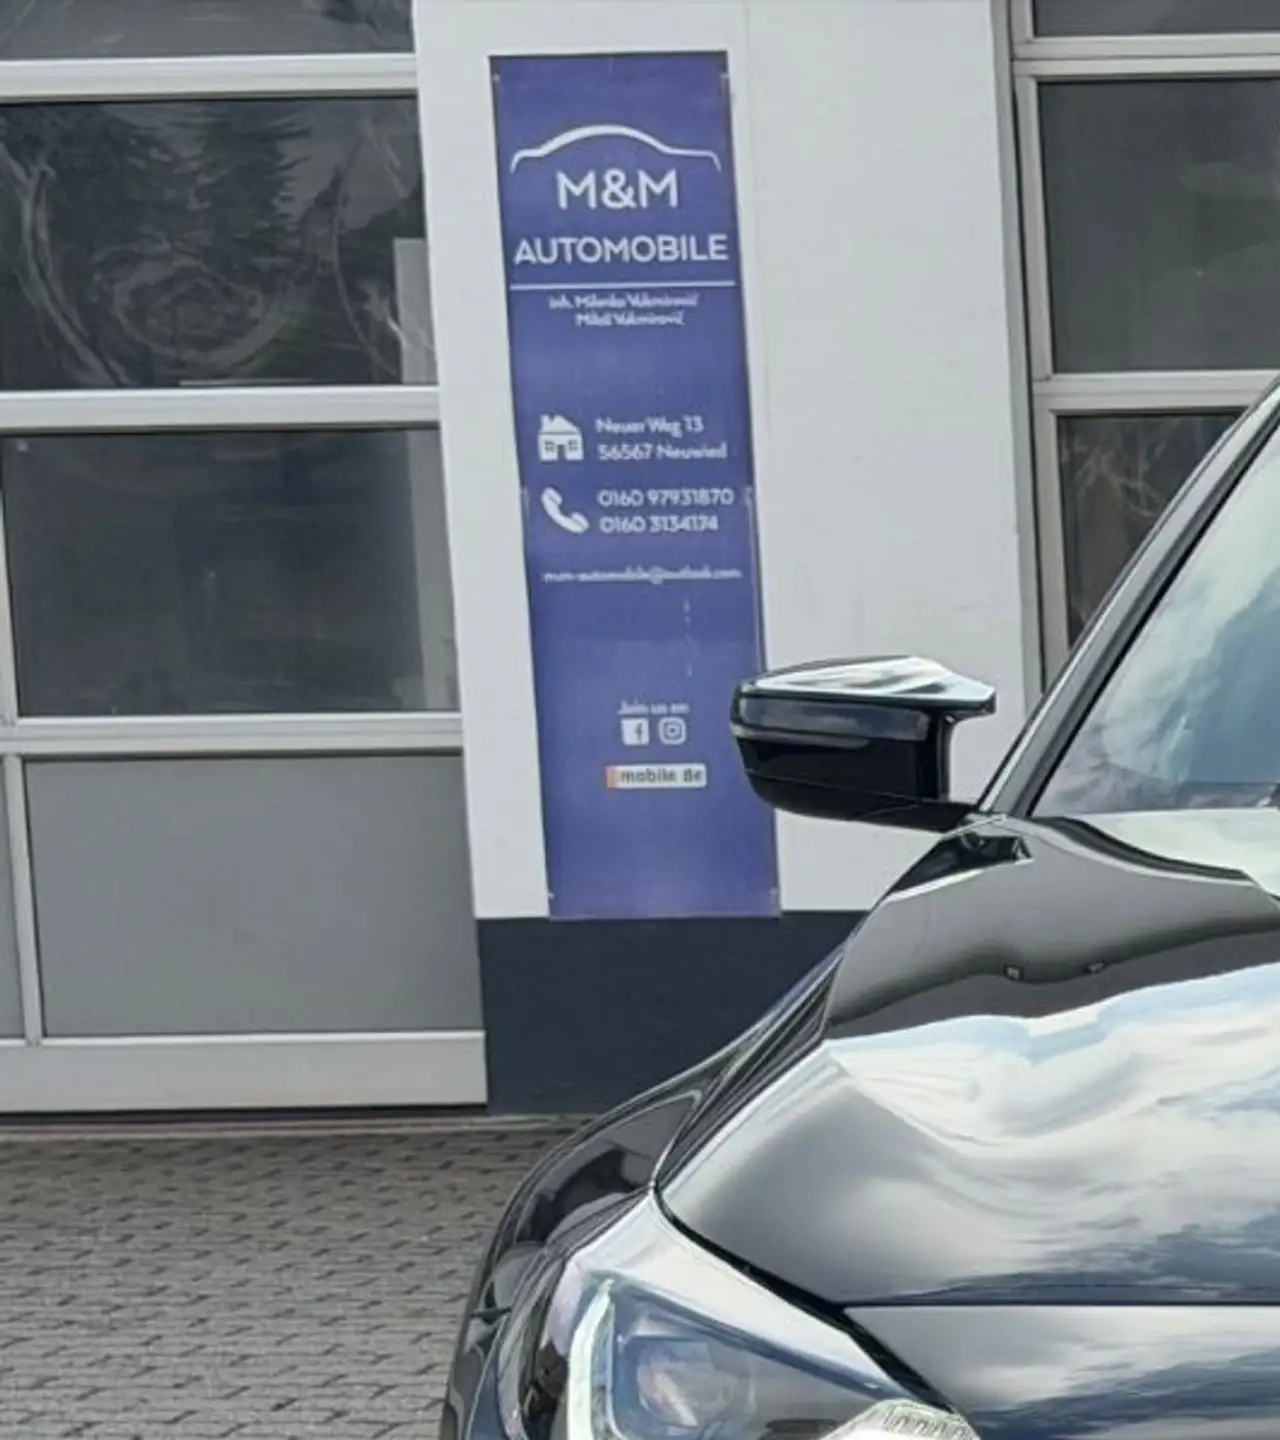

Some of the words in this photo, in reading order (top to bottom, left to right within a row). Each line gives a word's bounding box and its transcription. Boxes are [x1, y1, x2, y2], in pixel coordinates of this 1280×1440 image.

[556, 168, 679, 210] M&M
[513, 234, 729, 264] AUTOMOBILE
[597, 489, 644, 507] 0160
[600, 515, 647, 533] 0160
